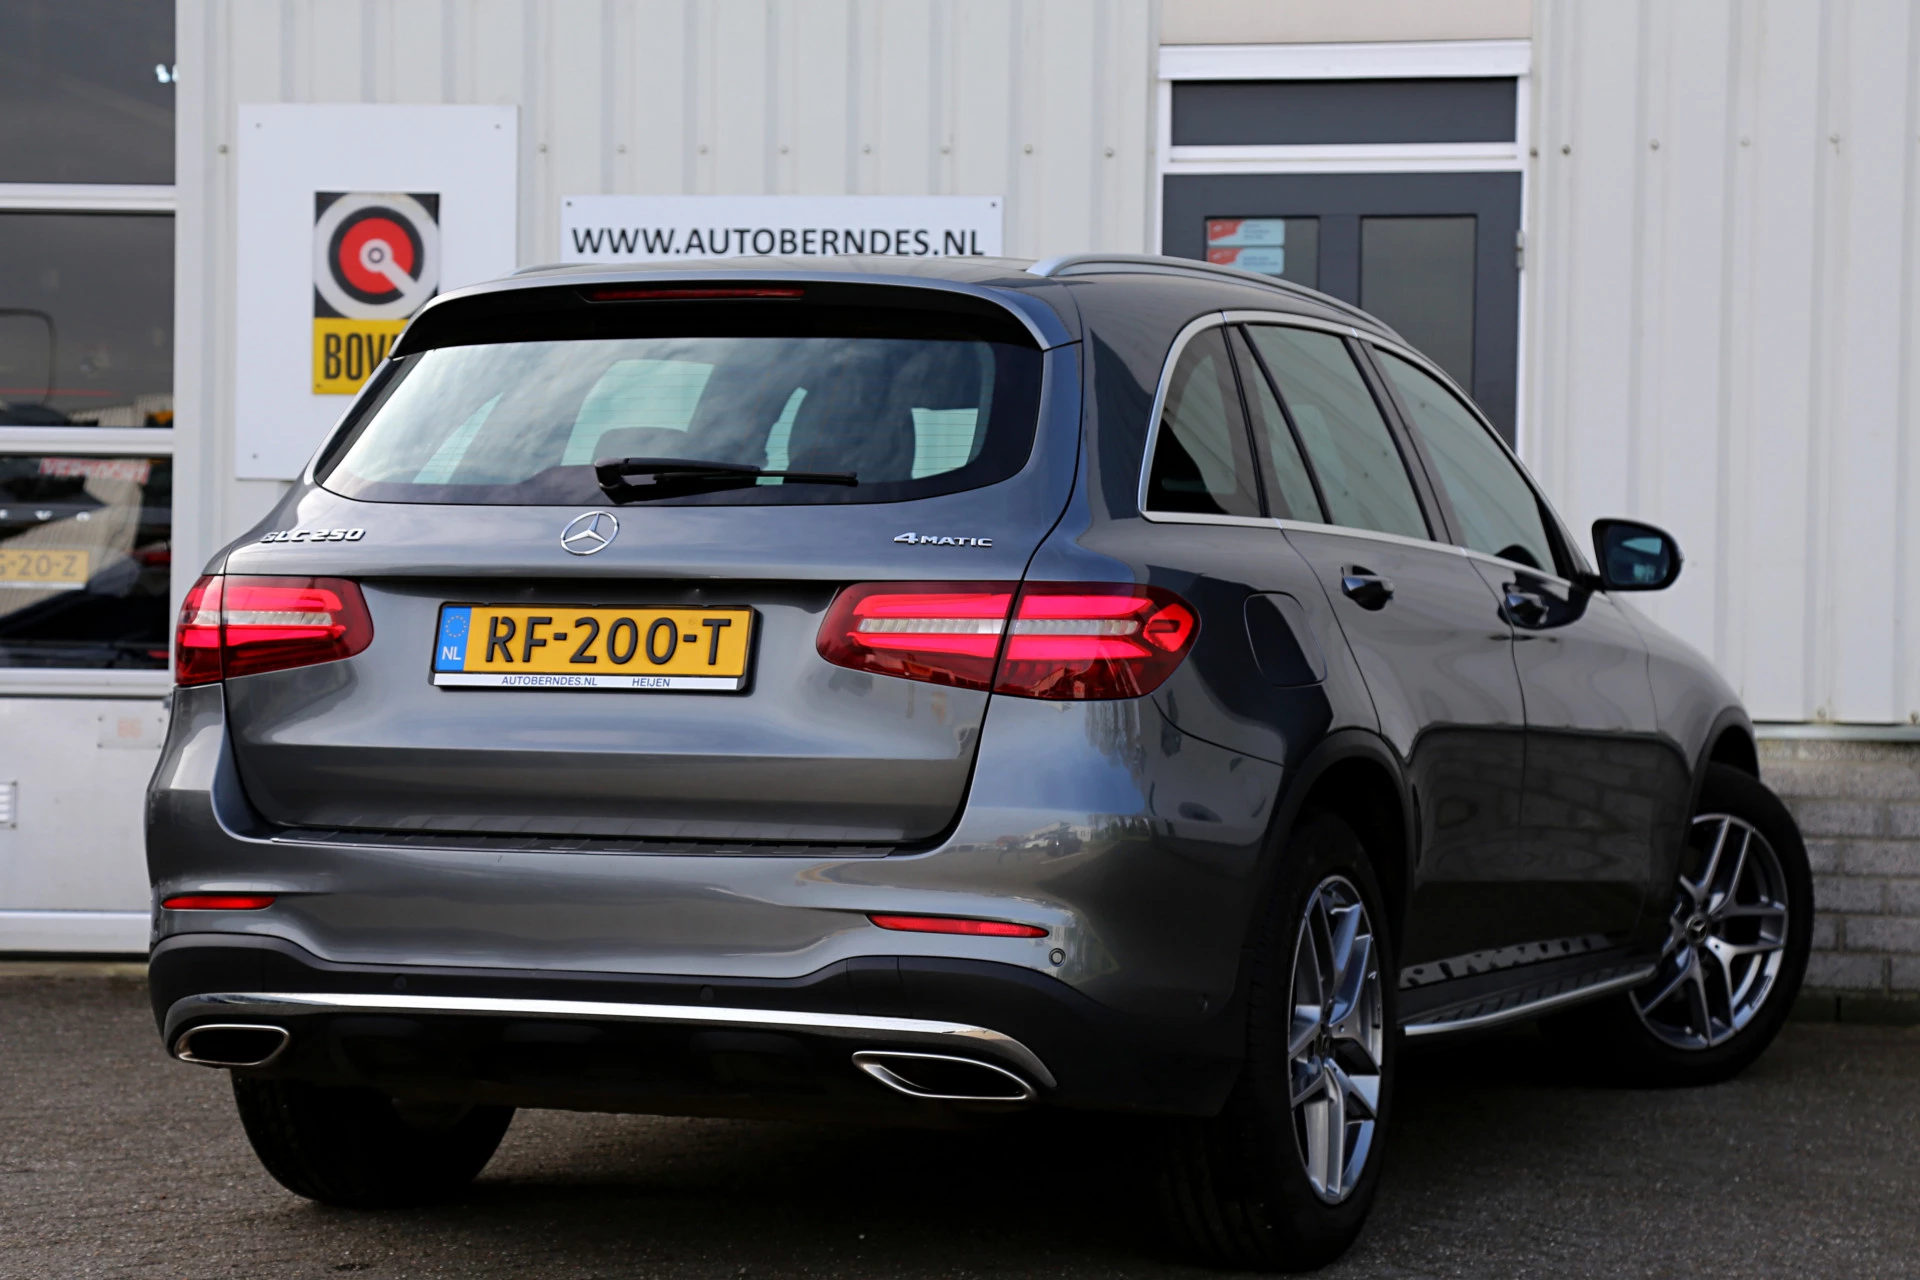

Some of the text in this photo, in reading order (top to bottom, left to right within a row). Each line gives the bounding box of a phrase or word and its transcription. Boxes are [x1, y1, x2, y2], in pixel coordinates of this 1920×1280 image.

[572, 227, 985, 257] WWW.AUTOBERNDES.NL
[323, 332, 399, 381] BOV
[260, 527, 366, 544] GLC 250
[893, 531, 993, 548] 4MATIC
[485, 616, 732, 666] RF-200-T
[441, 645, 462, 661] NL
[501, 675, 671, 688] AUTOBERNDES.NL HEIJEN
